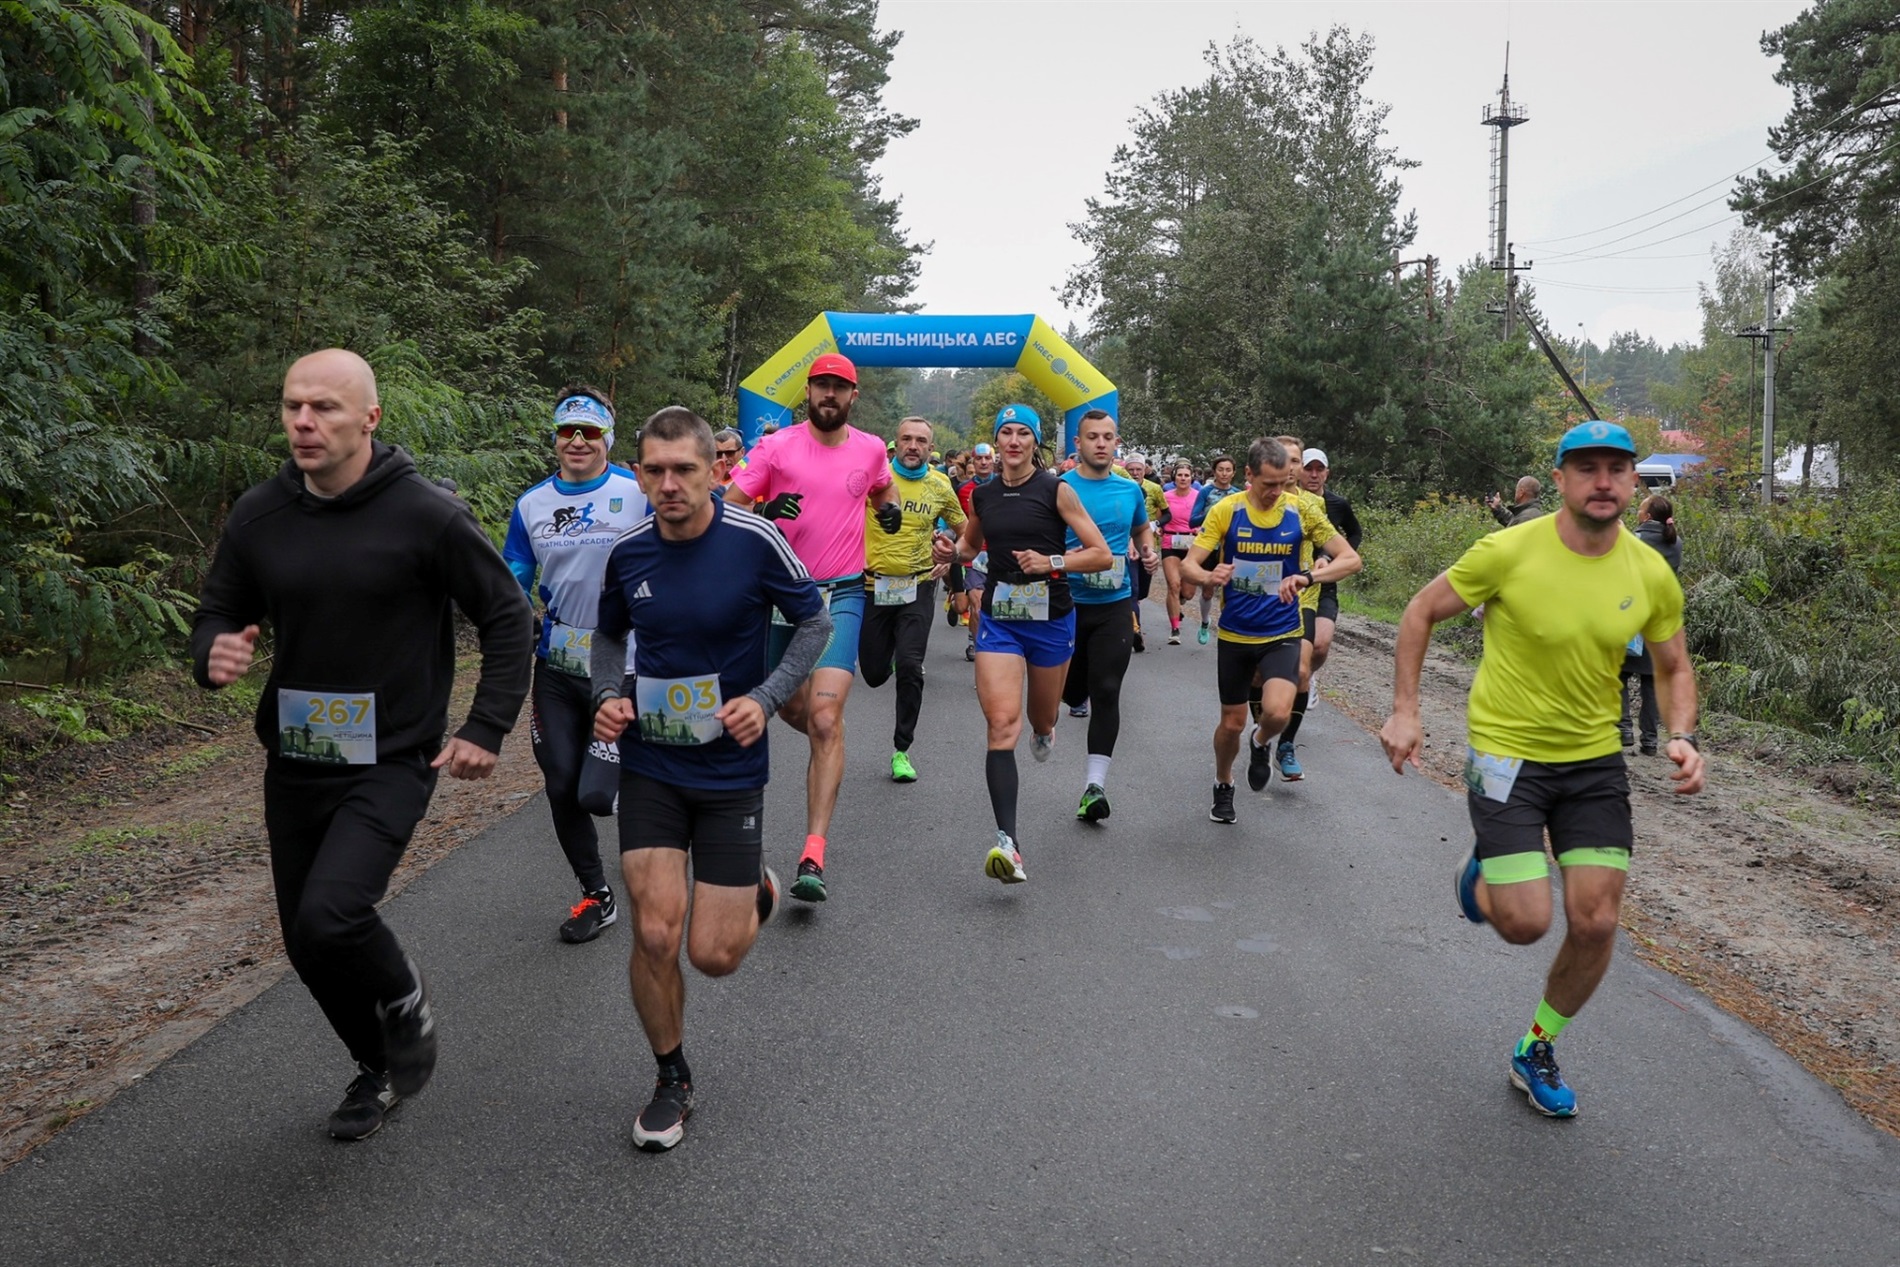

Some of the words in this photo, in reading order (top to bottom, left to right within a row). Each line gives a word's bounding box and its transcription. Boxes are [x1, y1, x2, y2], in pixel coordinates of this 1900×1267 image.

[845, 331, 979, 348] ХМЕЛЬНИЦЬКА
[982, 331, 1018, 346] АЕС
[1064, 371, 1091, 394] KhNPP
[903, 500, 932, 515] RUN
[1236, 541, 1294, 555] UKRAINE
[1256, 563, 1281, 577] 211
[1010, 583, 1048, 599] 203
[667, 680, 717, 712] 03
[308, 697, 371, 725] 267
